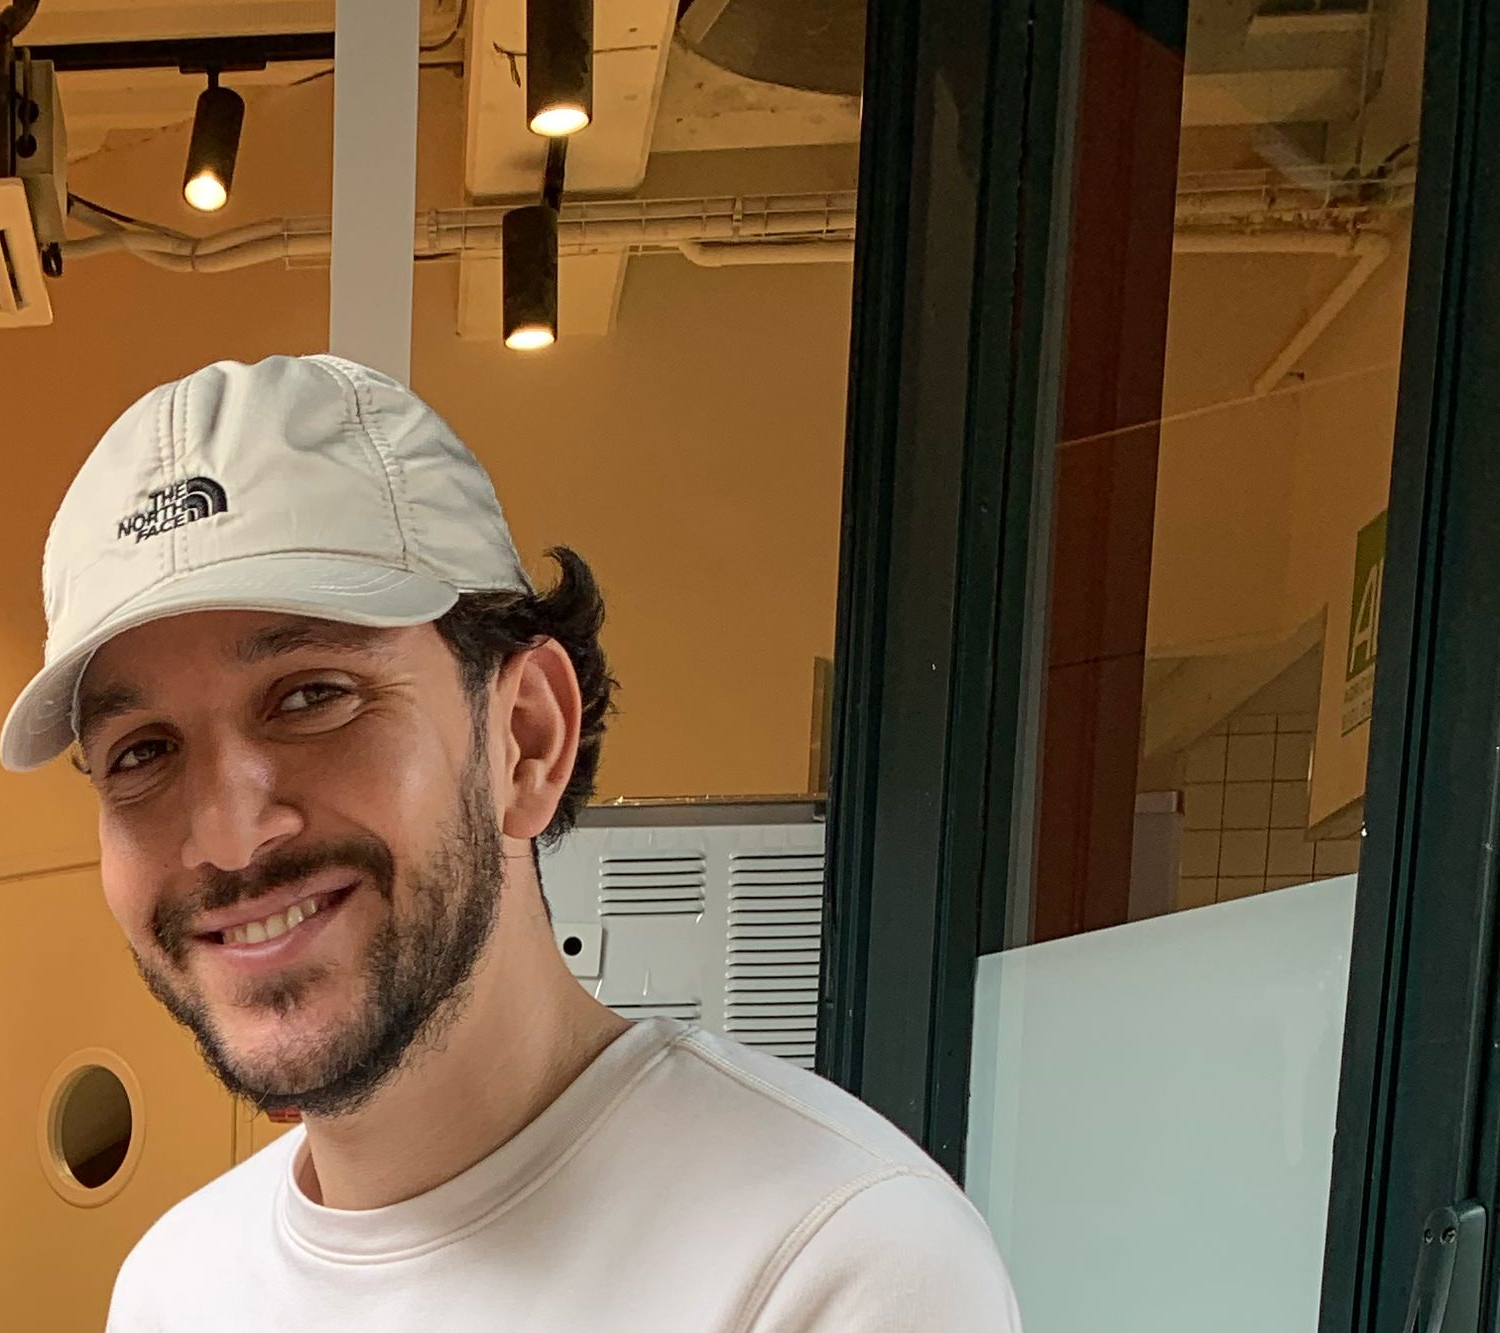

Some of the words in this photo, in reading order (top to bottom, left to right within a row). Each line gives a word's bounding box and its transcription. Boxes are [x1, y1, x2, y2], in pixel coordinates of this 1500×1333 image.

[149, 482, 187, 513] THE
[117, 504, 188, 540] NORTH
[135, 514, 185, 544] FACE
